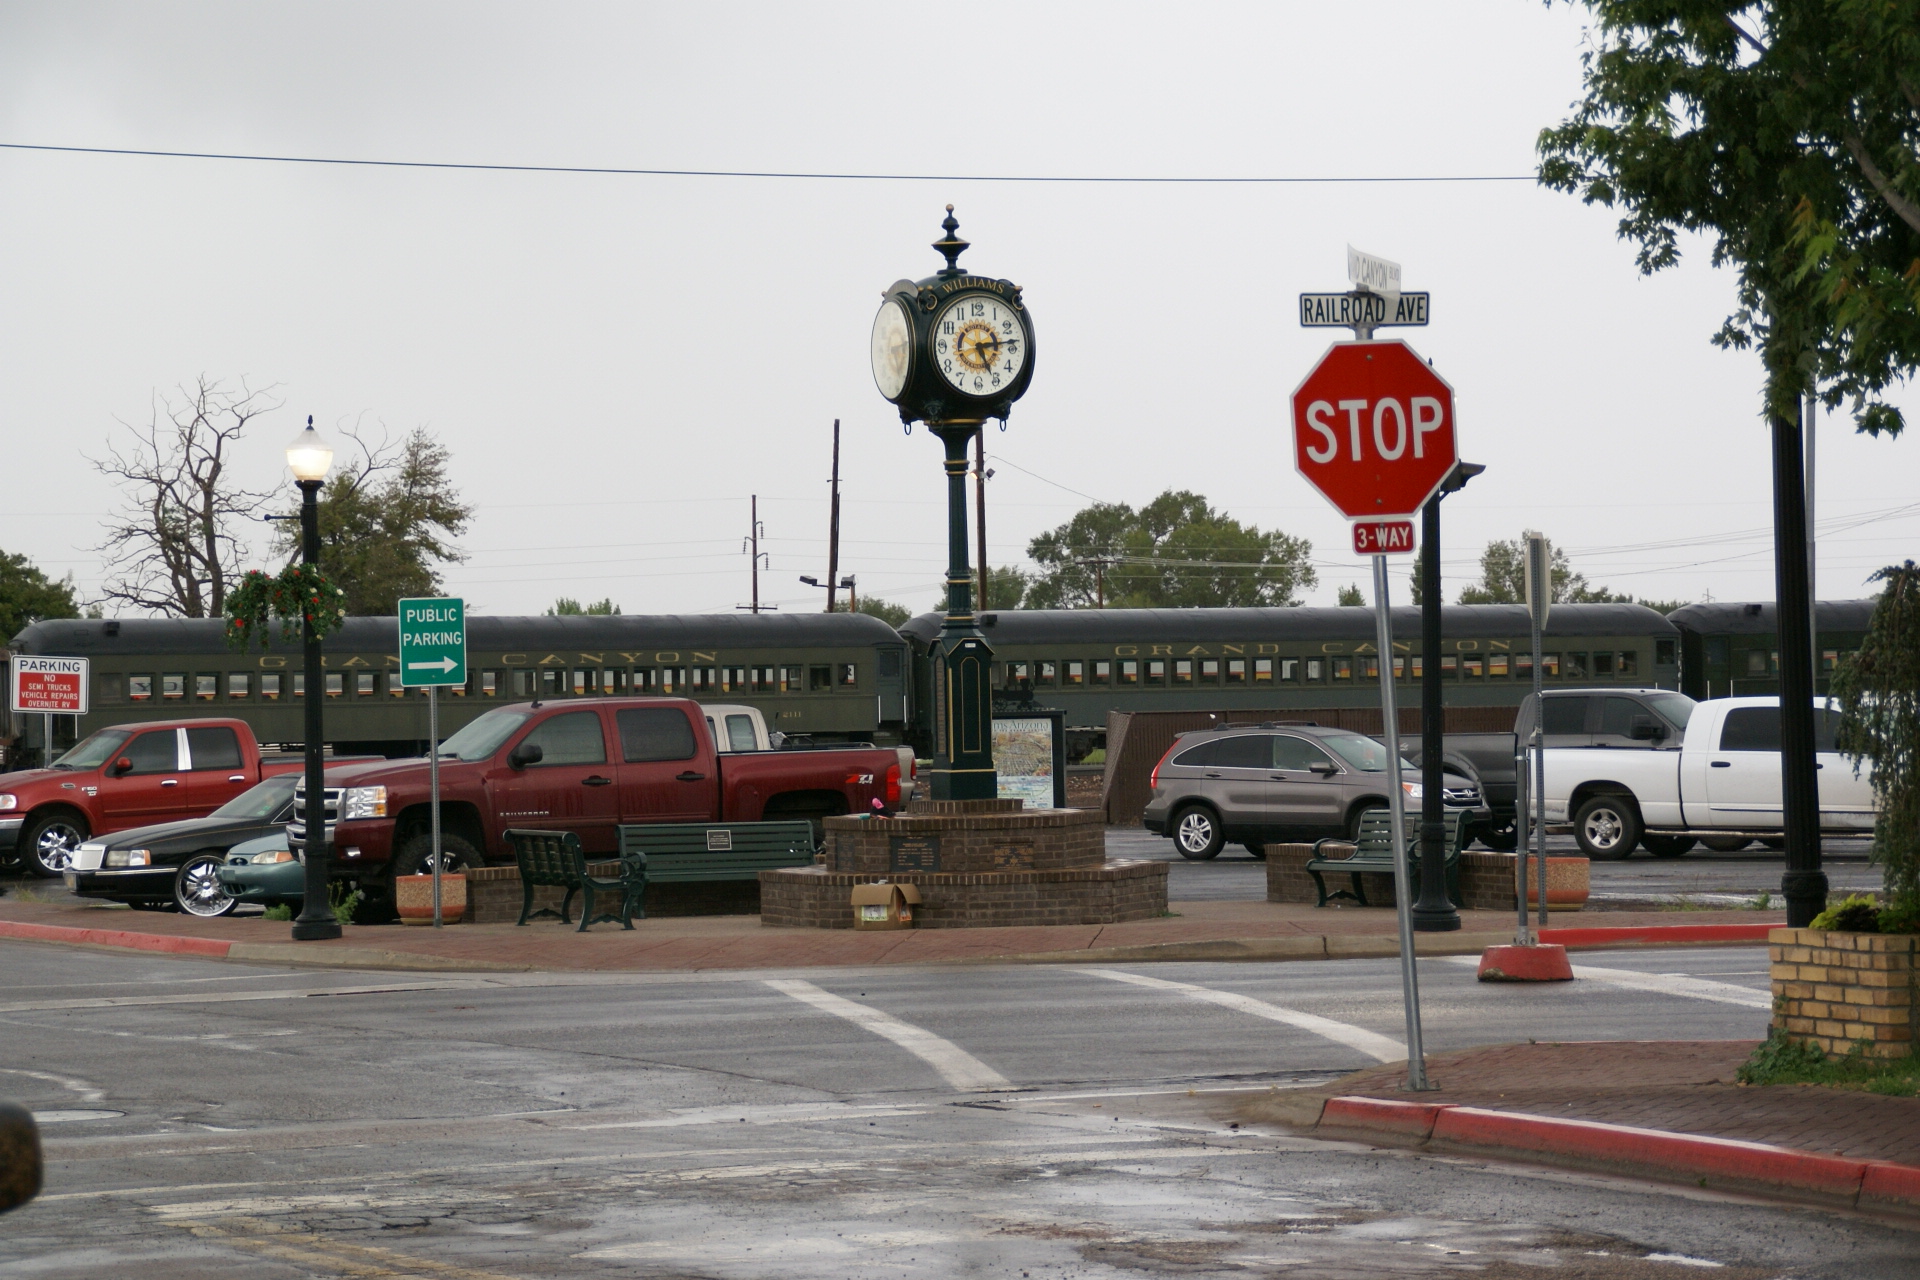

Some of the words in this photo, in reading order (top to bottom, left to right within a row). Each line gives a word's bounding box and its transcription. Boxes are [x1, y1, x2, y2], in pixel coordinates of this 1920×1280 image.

[1361, 257, 1387, 290] CANYON
[942, 278, 1005, 294] WILLIAMS
[956, 307, 965, 321] 11
[971, 302, 985, 317] 12
[993, 307, 997, 320] 1
[1303, 297, 1386, 323] RAILROAD
[1395, 297, 1426, 322] AVE
[943, 321, 955, 335] 10
[1002, 320, 1013, 334] 2
[938, 339, 948, 354] 9
[943, 359, 952, 373] 8
[1003, 359, 1013, 373] 4
[955, 371, 966, 386] 7
[973, 376, 984, 391] 6
[991, 372, 1001, 387] 5
[1306, 396, 1444, 464] STOP
[1357, 526, 1410, 549] 3-WAY
[406, 608, 457, 623] PUBLIC
[403, 631, 462, 647] PARKING
[1115, 644, 1279, 656] GRAND
[1322, 640, 1511, 653] CANON
[502, 651, 718, 665] CANYON
[20, 660, 80, 672] PARKING
[44, 674, 56, 682] NO
[28, 683, 44, 691] SEMI
[21, 691, 47, 699] VEHICLE
[28, 700, 58, 708] OVERNITE
[1009, 720, 1049, 729] Arizona
[846, 774, 873, 783] Z71
